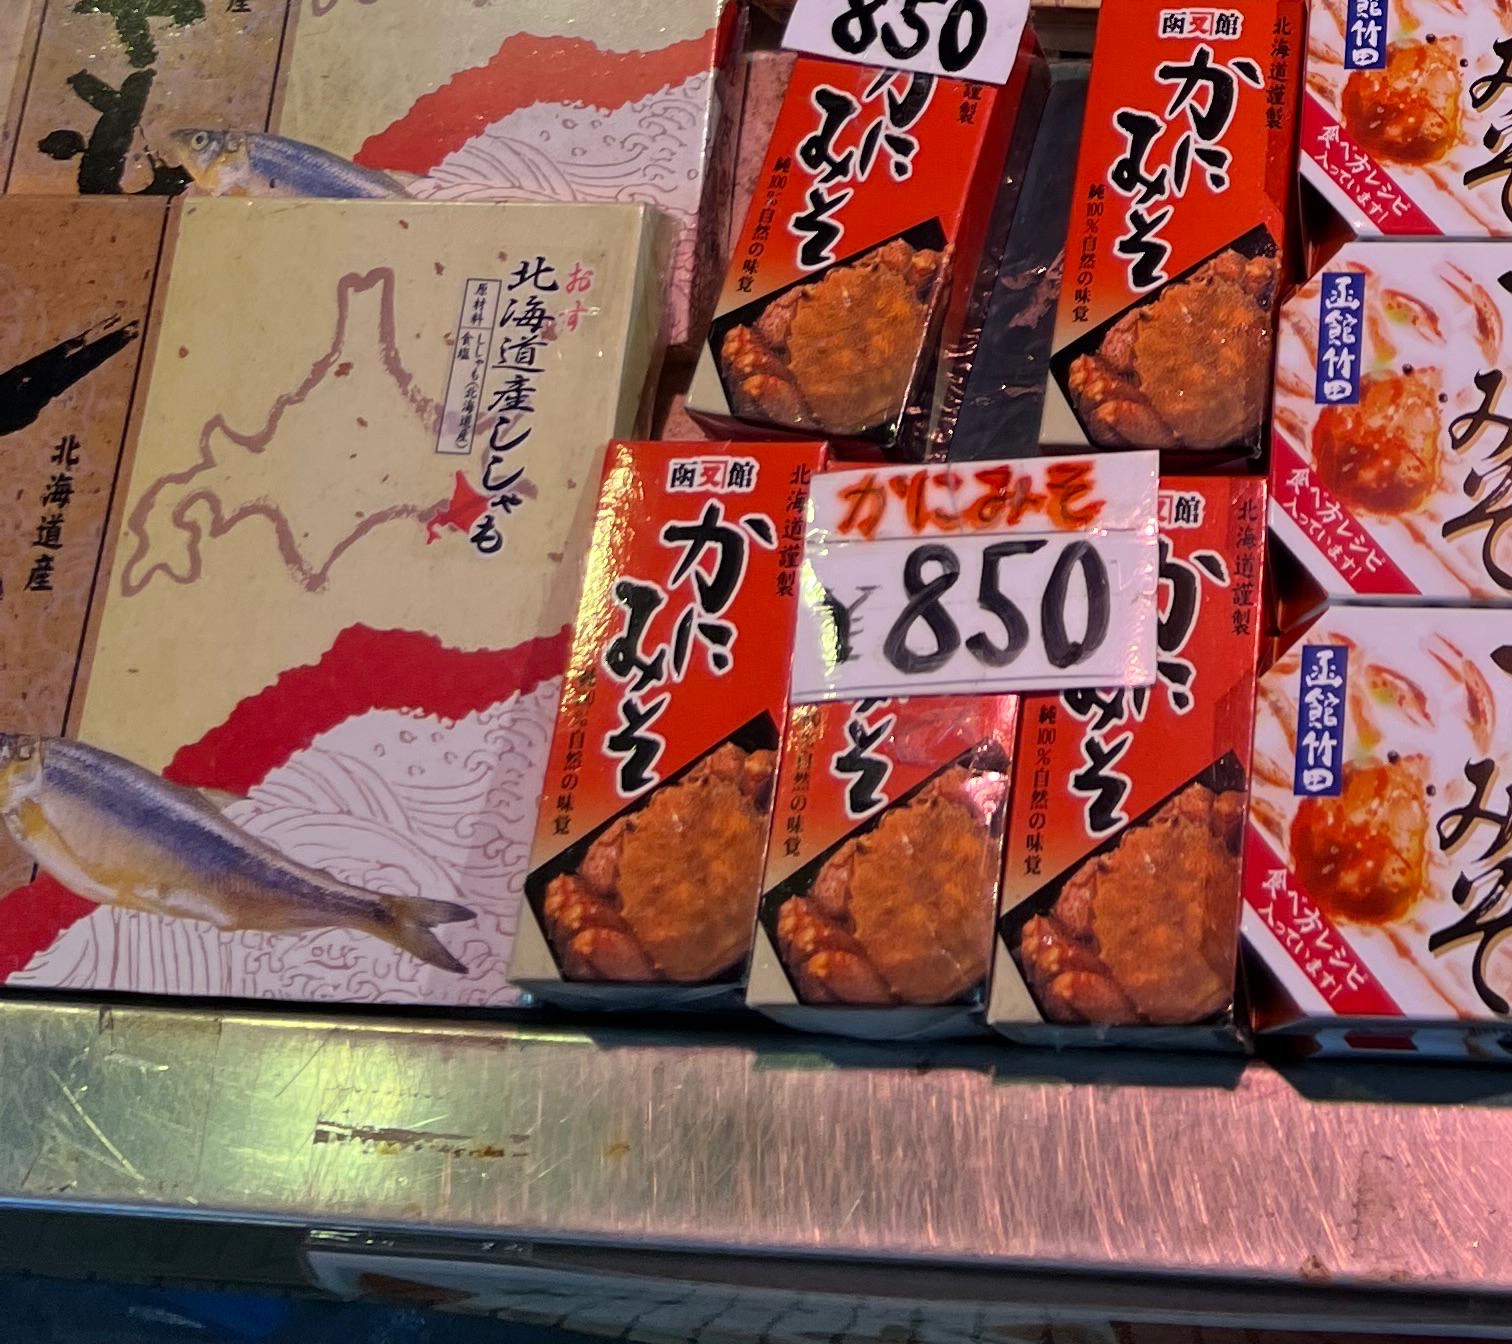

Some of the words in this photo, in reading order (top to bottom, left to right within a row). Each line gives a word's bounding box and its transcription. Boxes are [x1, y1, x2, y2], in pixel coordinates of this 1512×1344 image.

[1265, 16, 1294, 131] 北海道謹製
[1316, 124, 1411, 218] 食べ方レシピ
[470, 283, 488, 327] 原材料
[1071, 183, 1106, 324] 純100%自然の味覚
[457, 330, 474, 360] 食塩
[1322, 276, 1362, 402] 函館竹田
[470, 256, 559, 554] 北海道産ししゃも
[24, 435, 82, 592] 北海道産
[832, 460, 1110, 538] かにみそ
[1286, 466, 1387, 575] 食べ方レシピ
[820, 536, 1112, 675] ¥850
[1301, 649, 1344, 794] 函館竹田
[1022, 702, 1060, 879] 純100%自然の味覚
[1261, 867, 1365, 992] 食べ方レシピ
